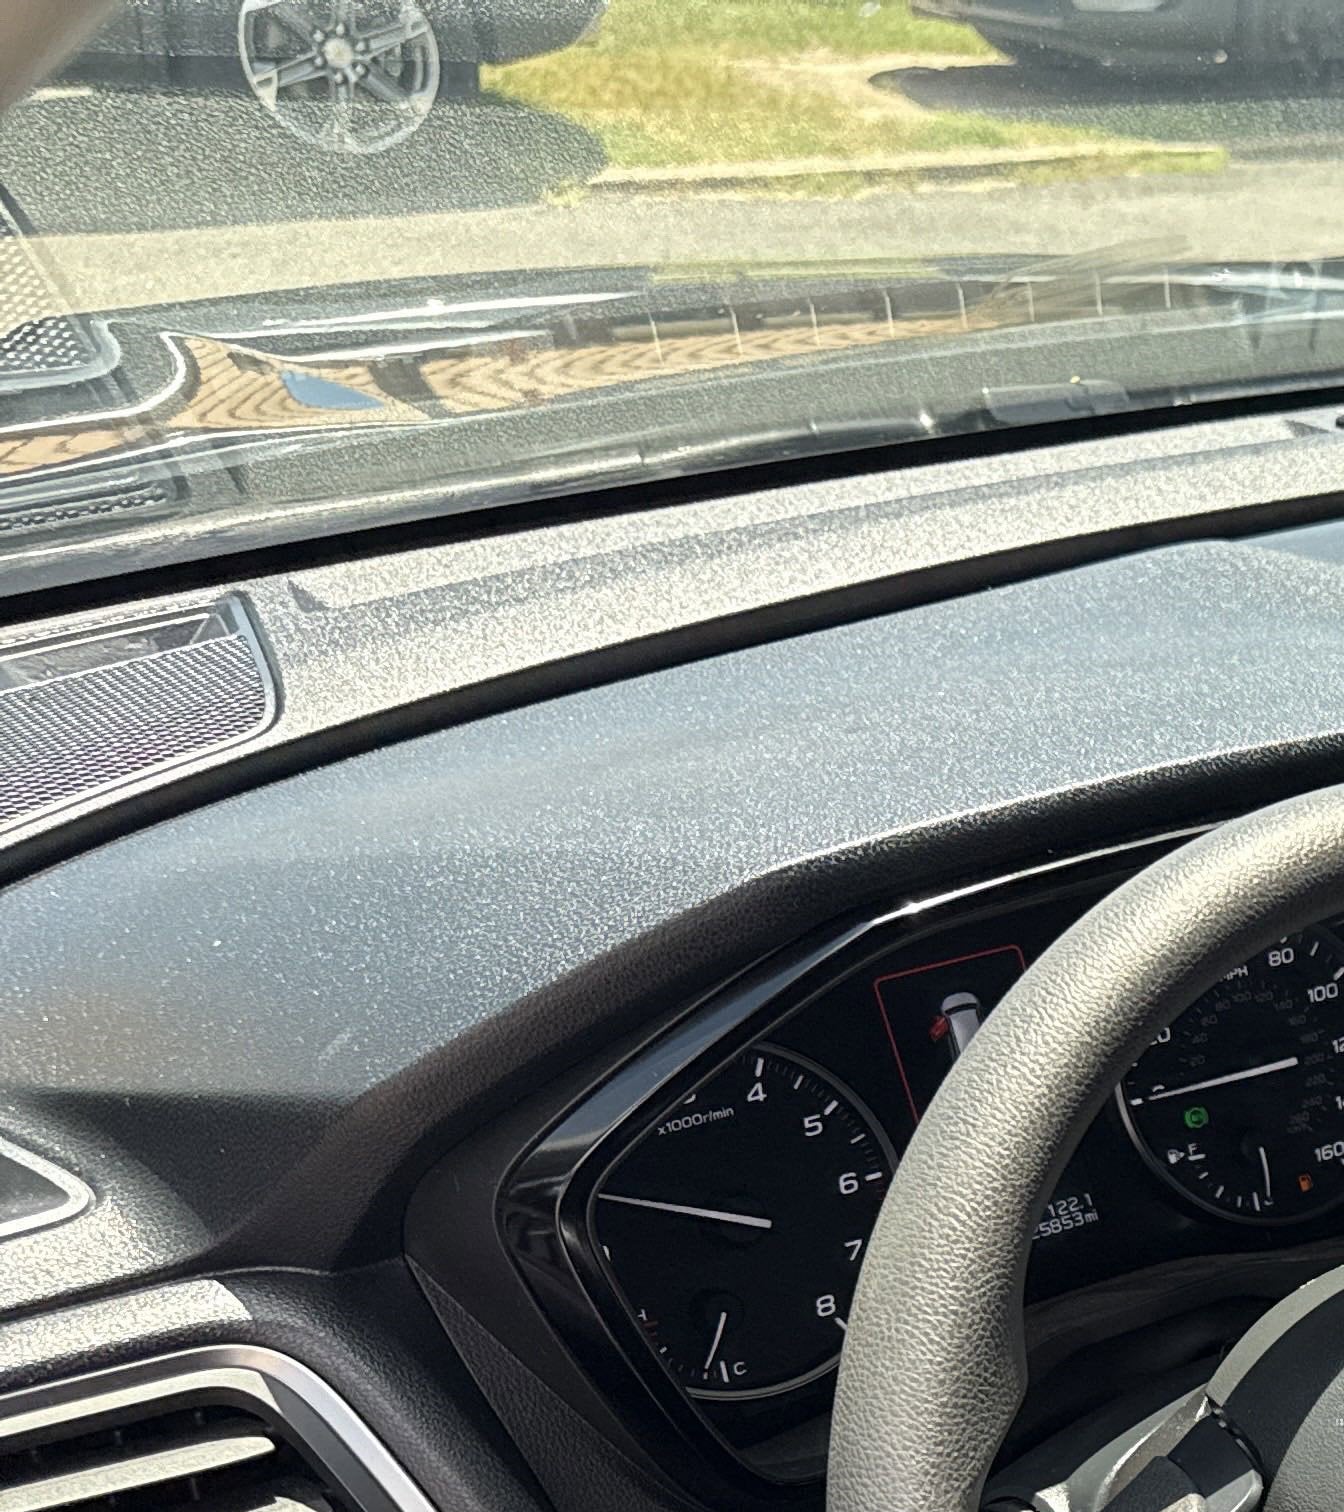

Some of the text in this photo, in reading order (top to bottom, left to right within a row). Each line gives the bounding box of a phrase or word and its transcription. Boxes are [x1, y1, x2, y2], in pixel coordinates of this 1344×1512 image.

[1268, 947, 1294, 967] 80
[1307, 982, 1339, 1003] 100
[747, 1082, 767, 1102] 4
[803, 1114, 824, 1137] 5
[1314, 1141, 1344, 1162] 160
[838, 1172, 859, 1195] 6
[1048, 1193, 1093, 1217] 122.1
[844, 1238, 863, 1261] 7
[815, 1294, 836, 1317] 8
[733, 1361, 747, 1377] C
